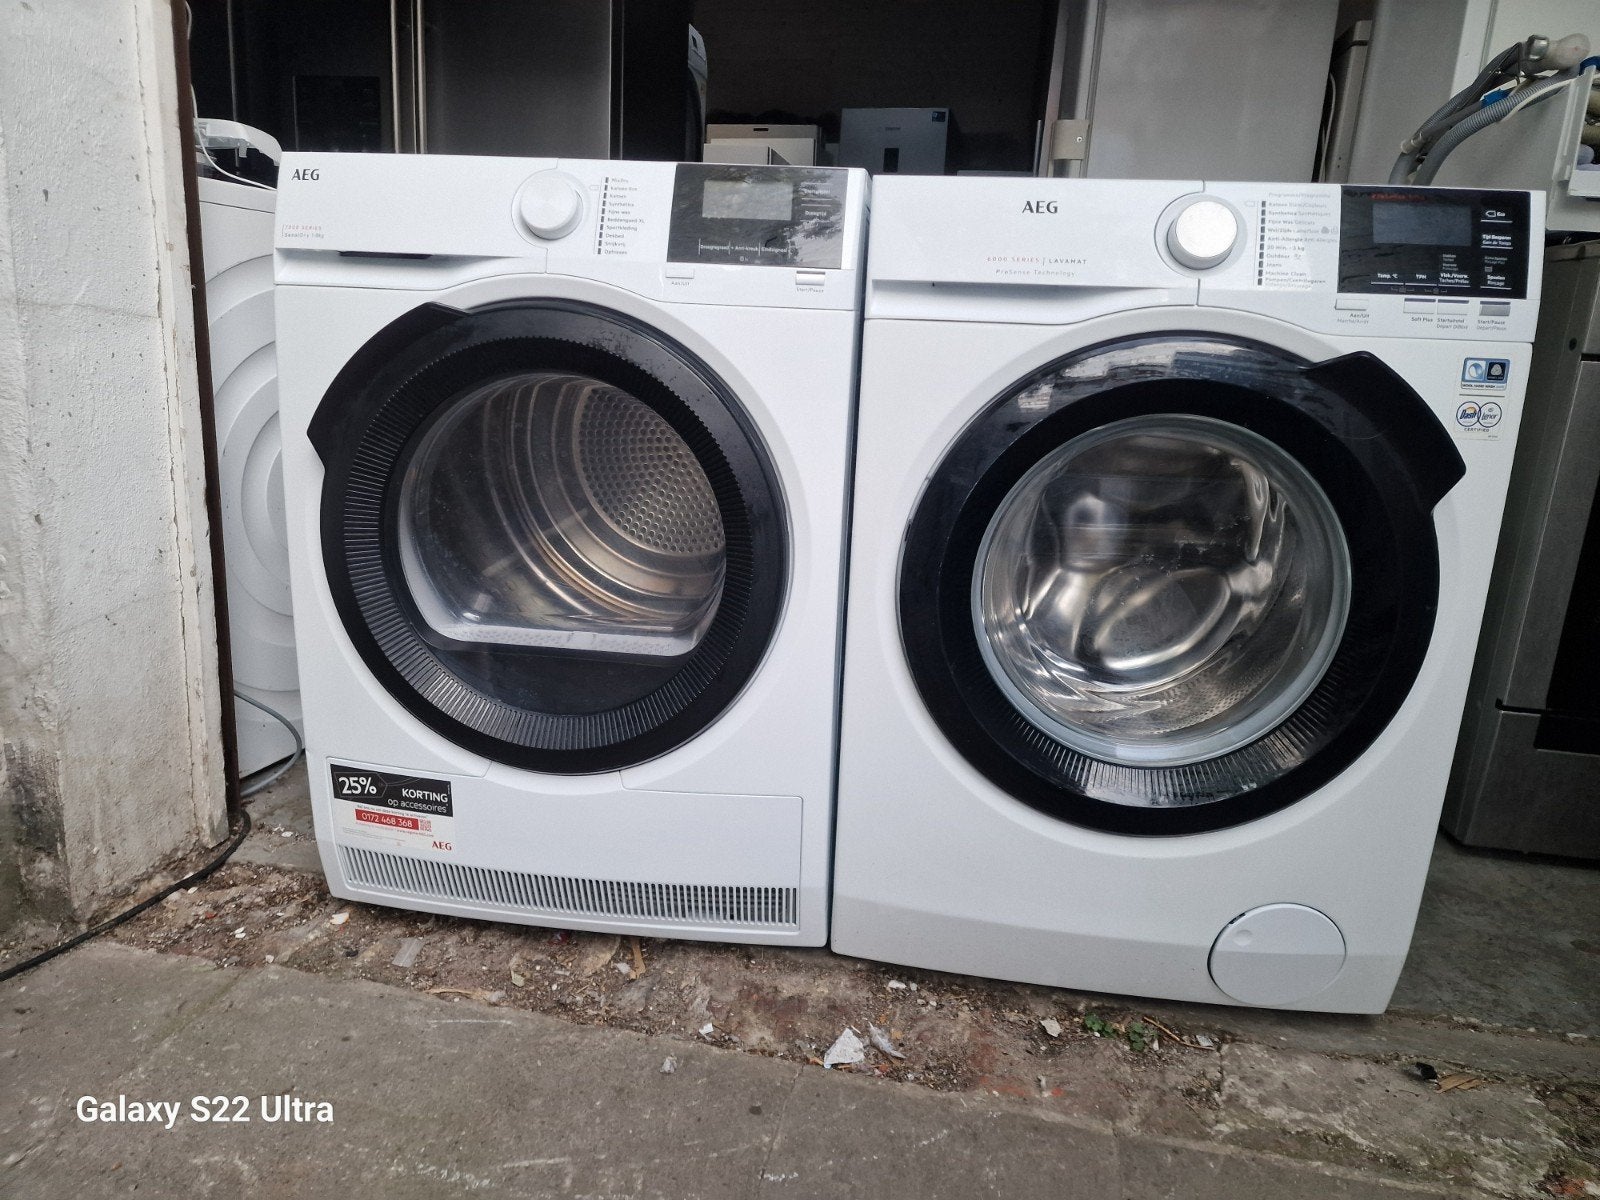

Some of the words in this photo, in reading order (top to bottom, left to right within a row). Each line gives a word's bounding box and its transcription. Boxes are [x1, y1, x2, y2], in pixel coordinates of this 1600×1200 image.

[291, 168, 320, 181] AEG
[1022, 200, 1058, 214] AEG
[1034, 269, 1076, 277] Technology
[1459, 408, 1478, 420] Dash
[338, 776, 377, 795] 25%
[401, 788, 448, 803] KORTING
[387, 798, 399, 808] op
[400, 800, 447, 814] accessoires
[361, 812, 379, 822] 0172
[381, 816, 397, 826] 468
[398, 818, 413, 828] 368
[431, 840, 452, 851] AEG
